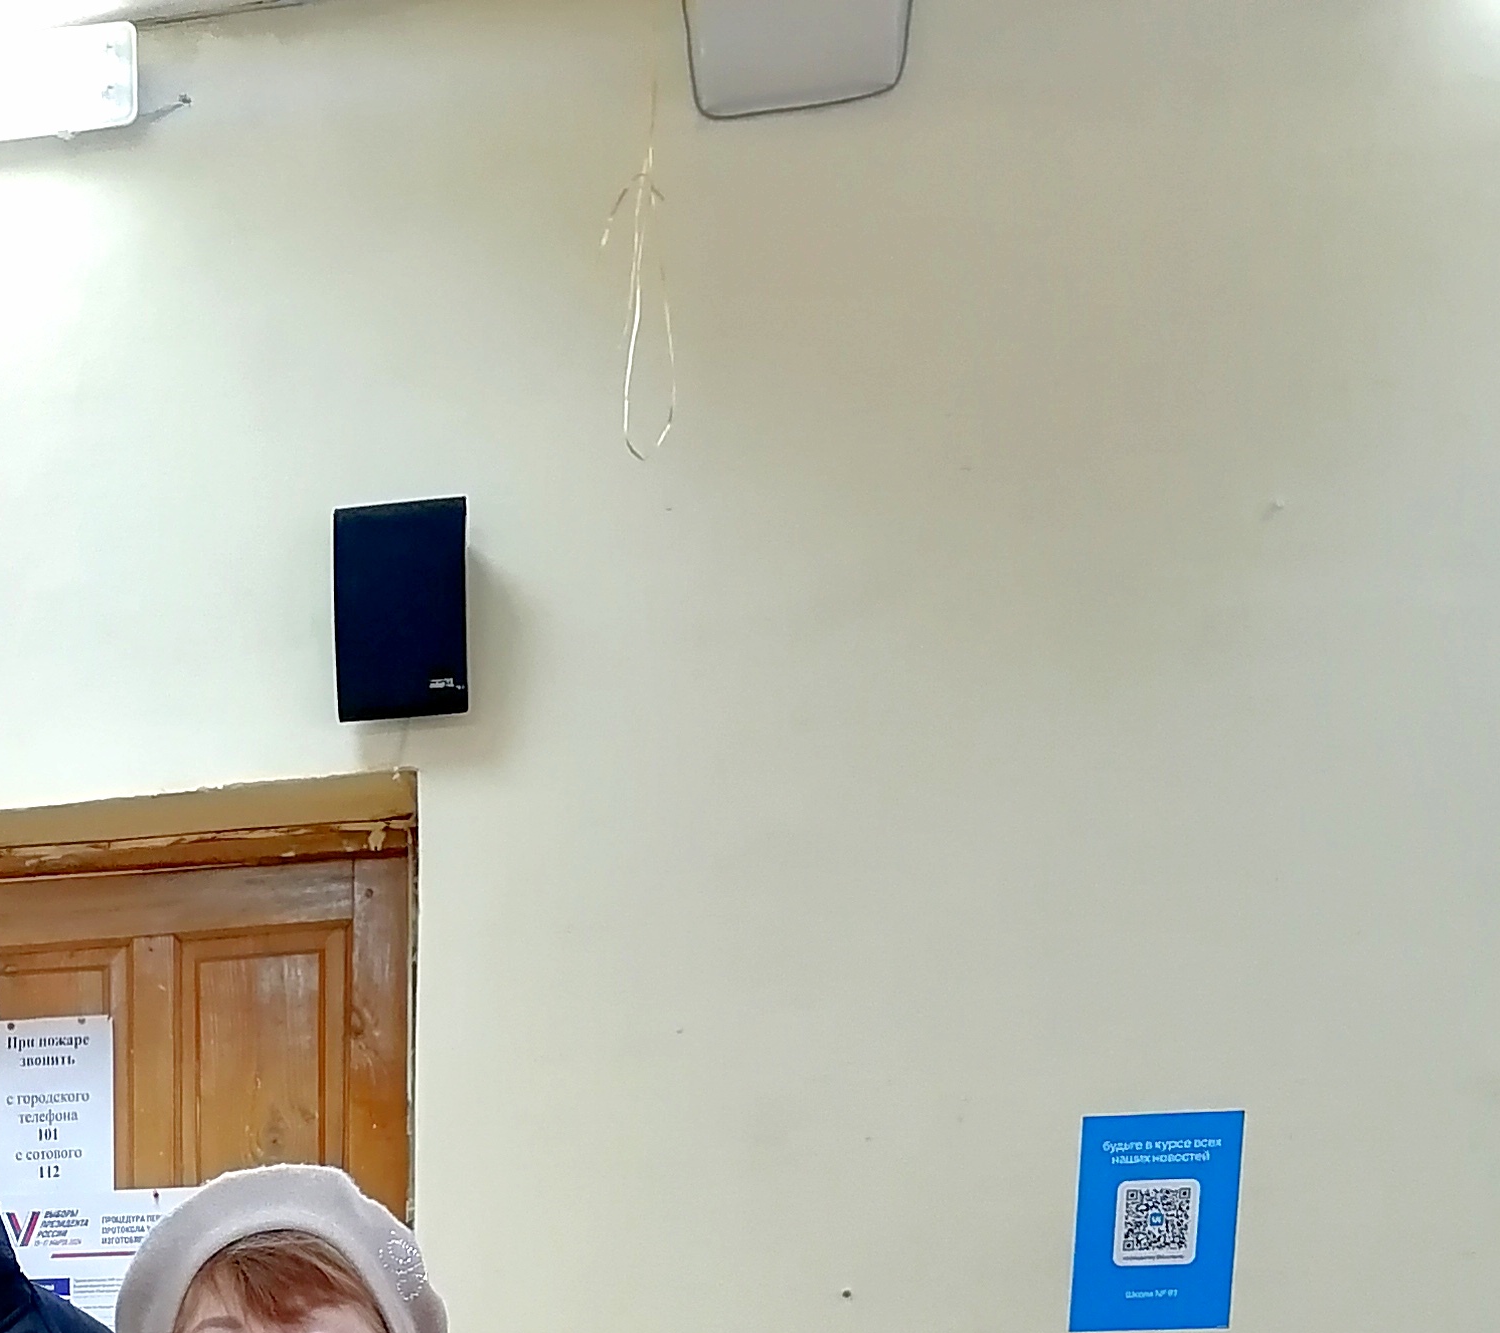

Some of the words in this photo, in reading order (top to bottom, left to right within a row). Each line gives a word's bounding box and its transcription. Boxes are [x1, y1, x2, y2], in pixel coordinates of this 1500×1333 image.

[7, 1035, 35, 1052] При
[38, 1034, 90, 1049] пожаре
[19, 1055, 76, 1068] звонить
[6, 1094, 14, 1105] с
[16, 1091, 90, 1108] городского
[17, 1108, 79, 1126] телефона
[38, 1127, 58, 1141] 101
[1102, 1140, 1143, 1154] будьте
[1155, 1138, 1192, 1151] курсе
[15, 1150, 23, 1161] с
[25, 1148, 83, 1161] сотового
[1111, 1154, 1151, 1165] наших
[1152, 1150, 1211, 1163] новостей
[39, 1165, 61, 1179] 112
